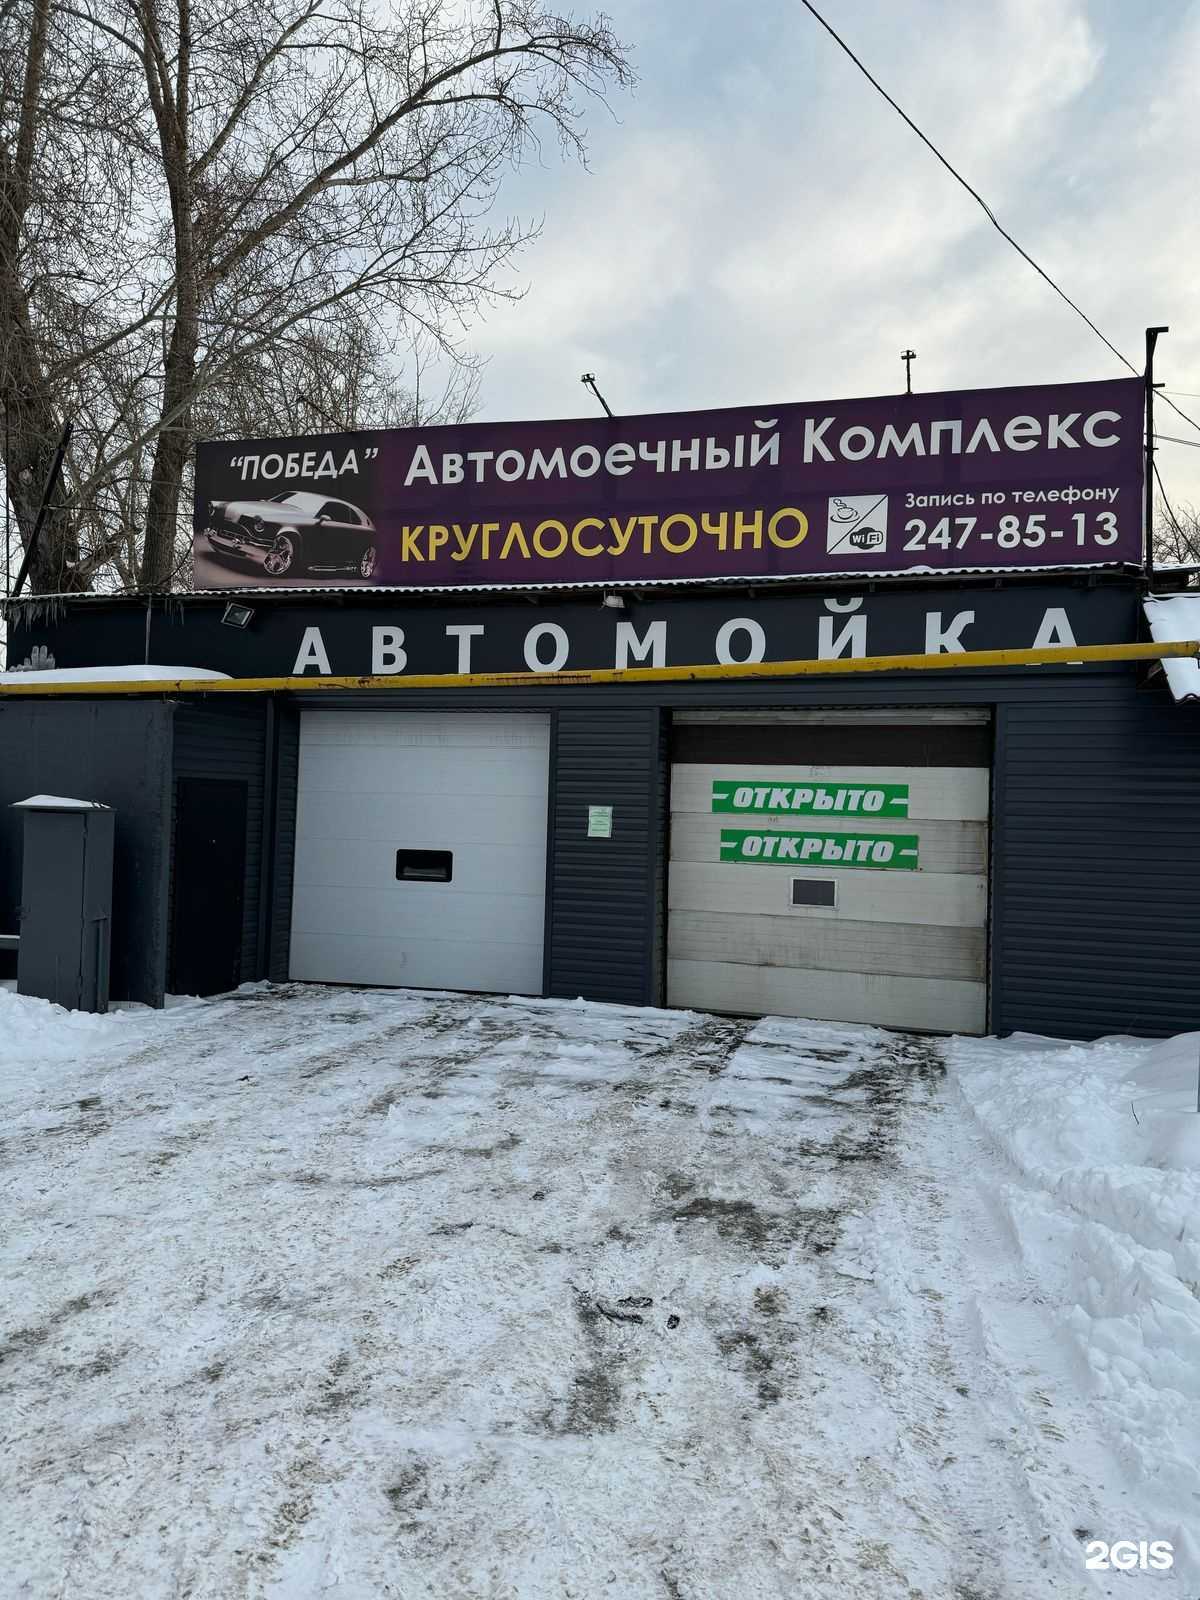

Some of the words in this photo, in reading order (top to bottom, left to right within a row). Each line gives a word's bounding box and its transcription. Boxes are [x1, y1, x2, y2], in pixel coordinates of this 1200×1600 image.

[404, 418, 780, 487] Автомоечный
[803, 409, 1122, 464] Комплекс
[904, 490, 975, 509] Запись
[981, 490, 1006, 504] по
[1011, 485, 1120, 504] телефону
[401, 507, 809, 562] КРУГЛОСУТОЧНО
[902, 511, 1119, 552] 247-85-13
[292, 597, 1083, 675] АВТОМОЙКА
[732, 787, 886, 812] ОТКРЫТО
[741, 835, 895, 862] ОТКРЫТО
